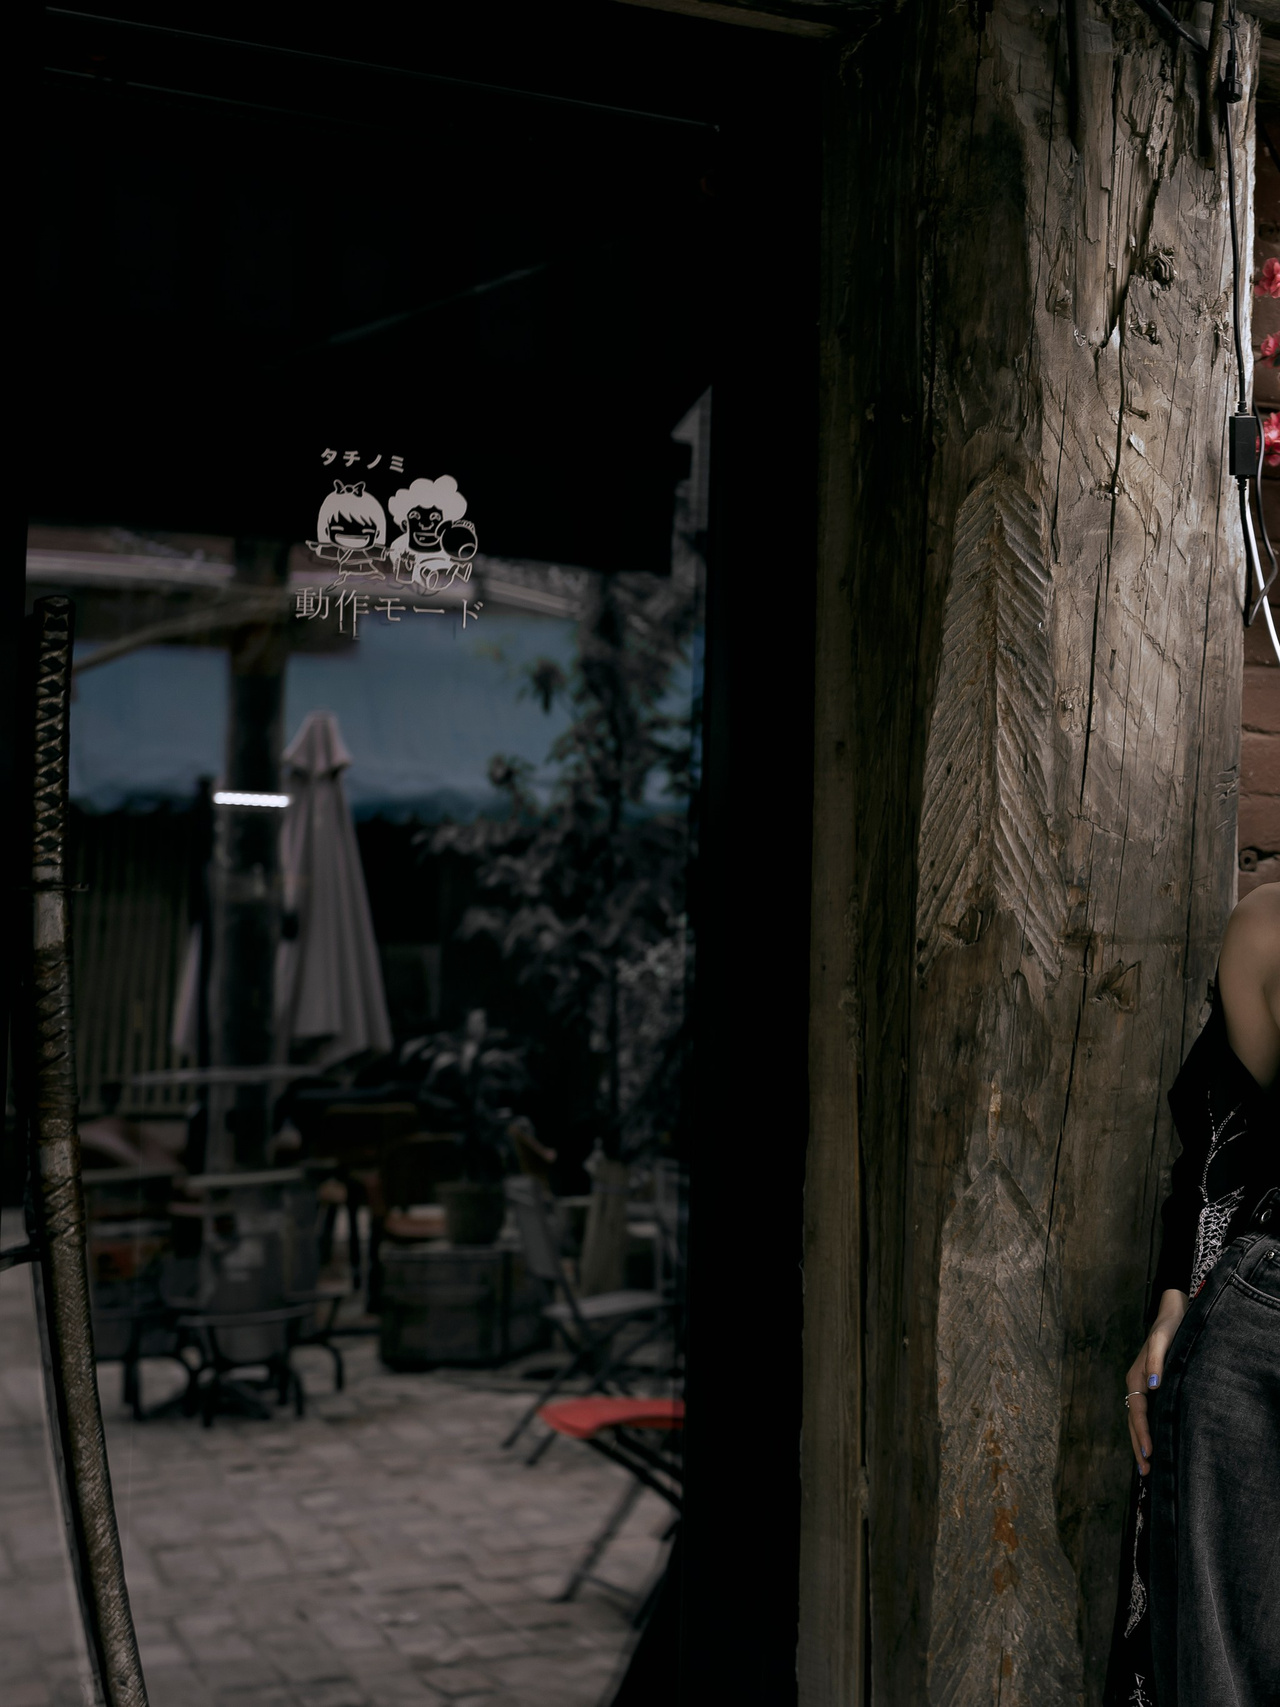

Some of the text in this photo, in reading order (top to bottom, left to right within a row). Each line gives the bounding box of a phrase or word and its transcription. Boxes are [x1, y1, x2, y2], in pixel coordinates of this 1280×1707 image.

[321, 448, 404, 473] タチノミ
[295, 587, 484, 630] 動作モード
